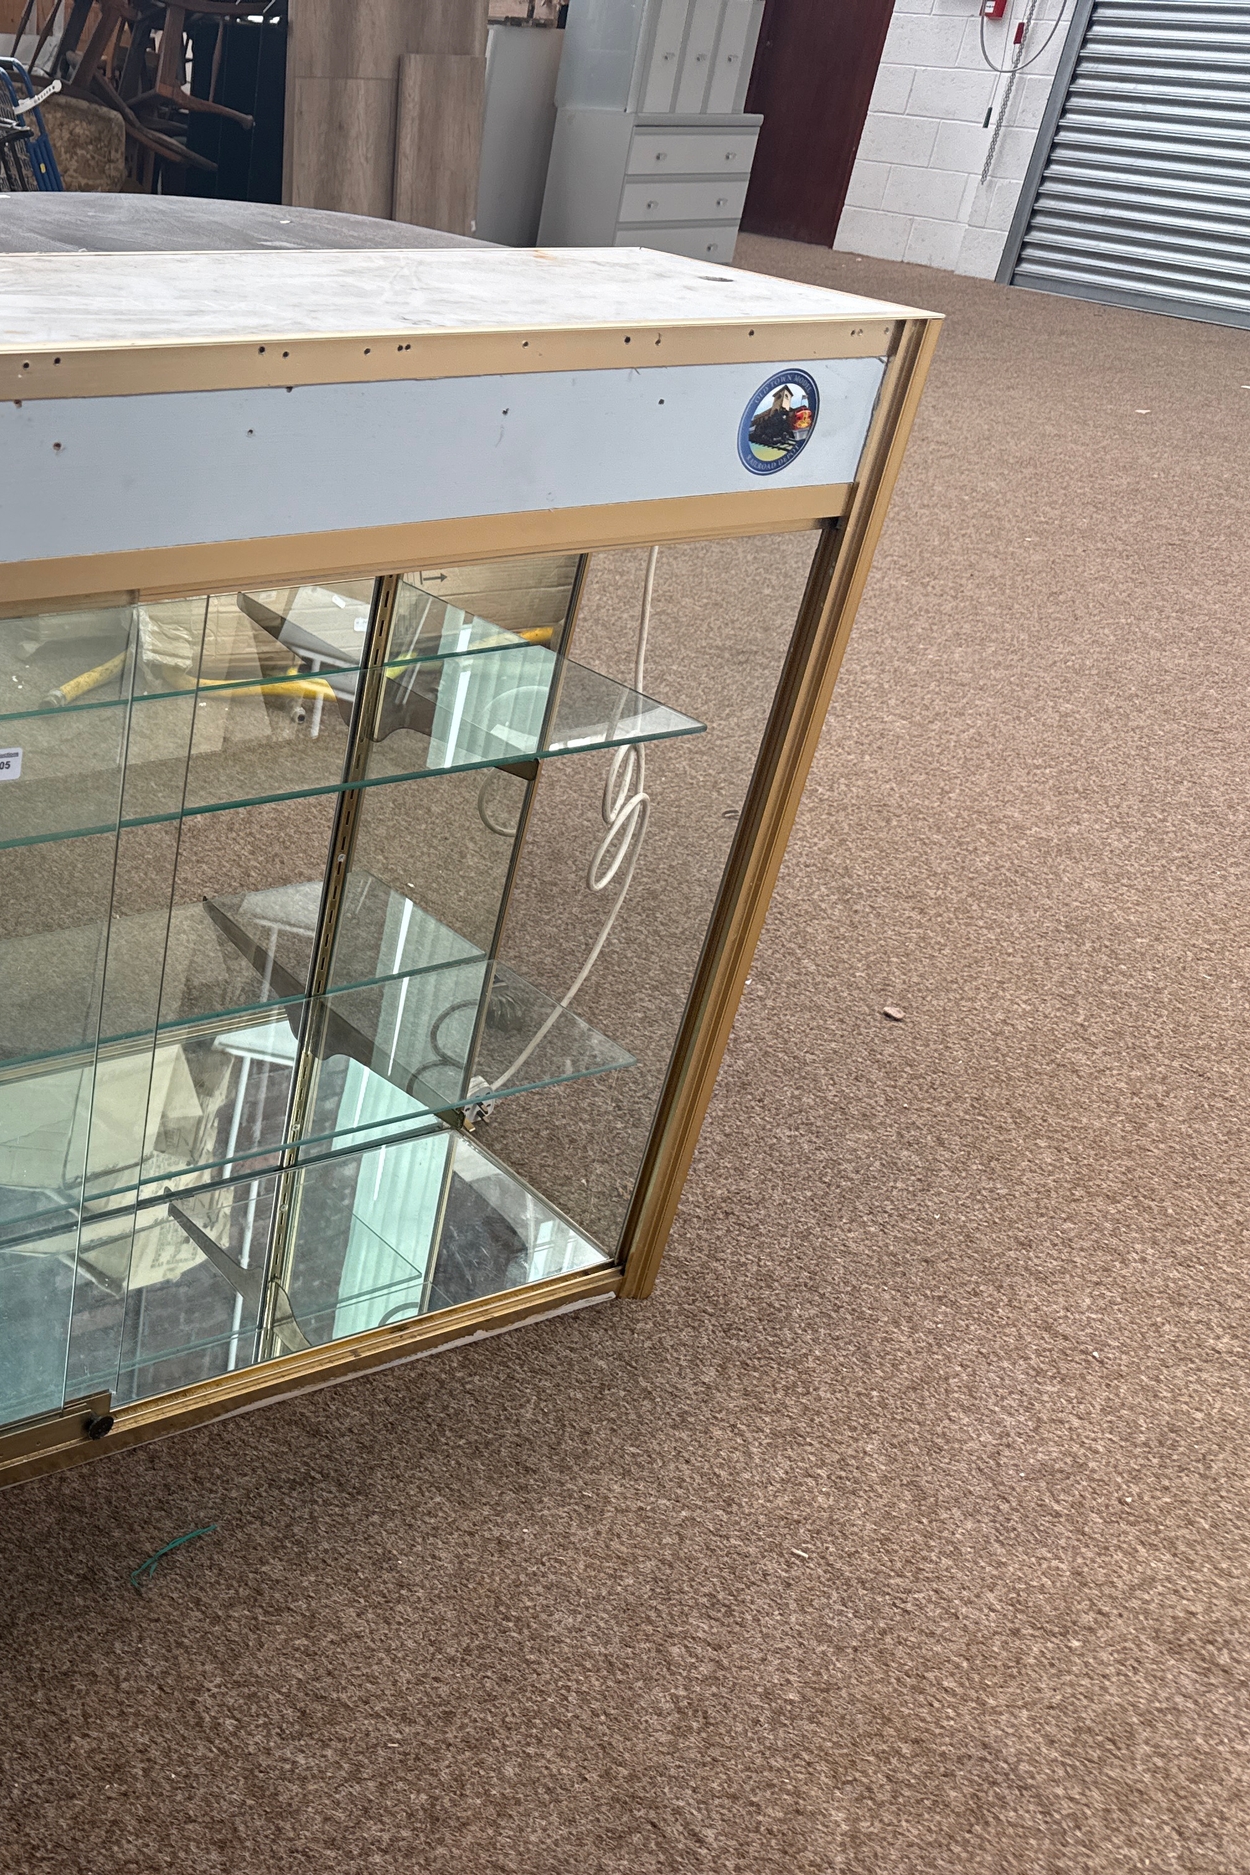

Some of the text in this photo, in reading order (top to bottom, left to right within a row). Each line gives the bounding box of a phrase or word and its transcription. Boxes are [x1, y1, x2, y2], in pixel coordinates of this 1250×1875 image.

[754, 374, 812, 404] OLD TOWN MODEL
[778, 444, 799, 467] DEPOT
